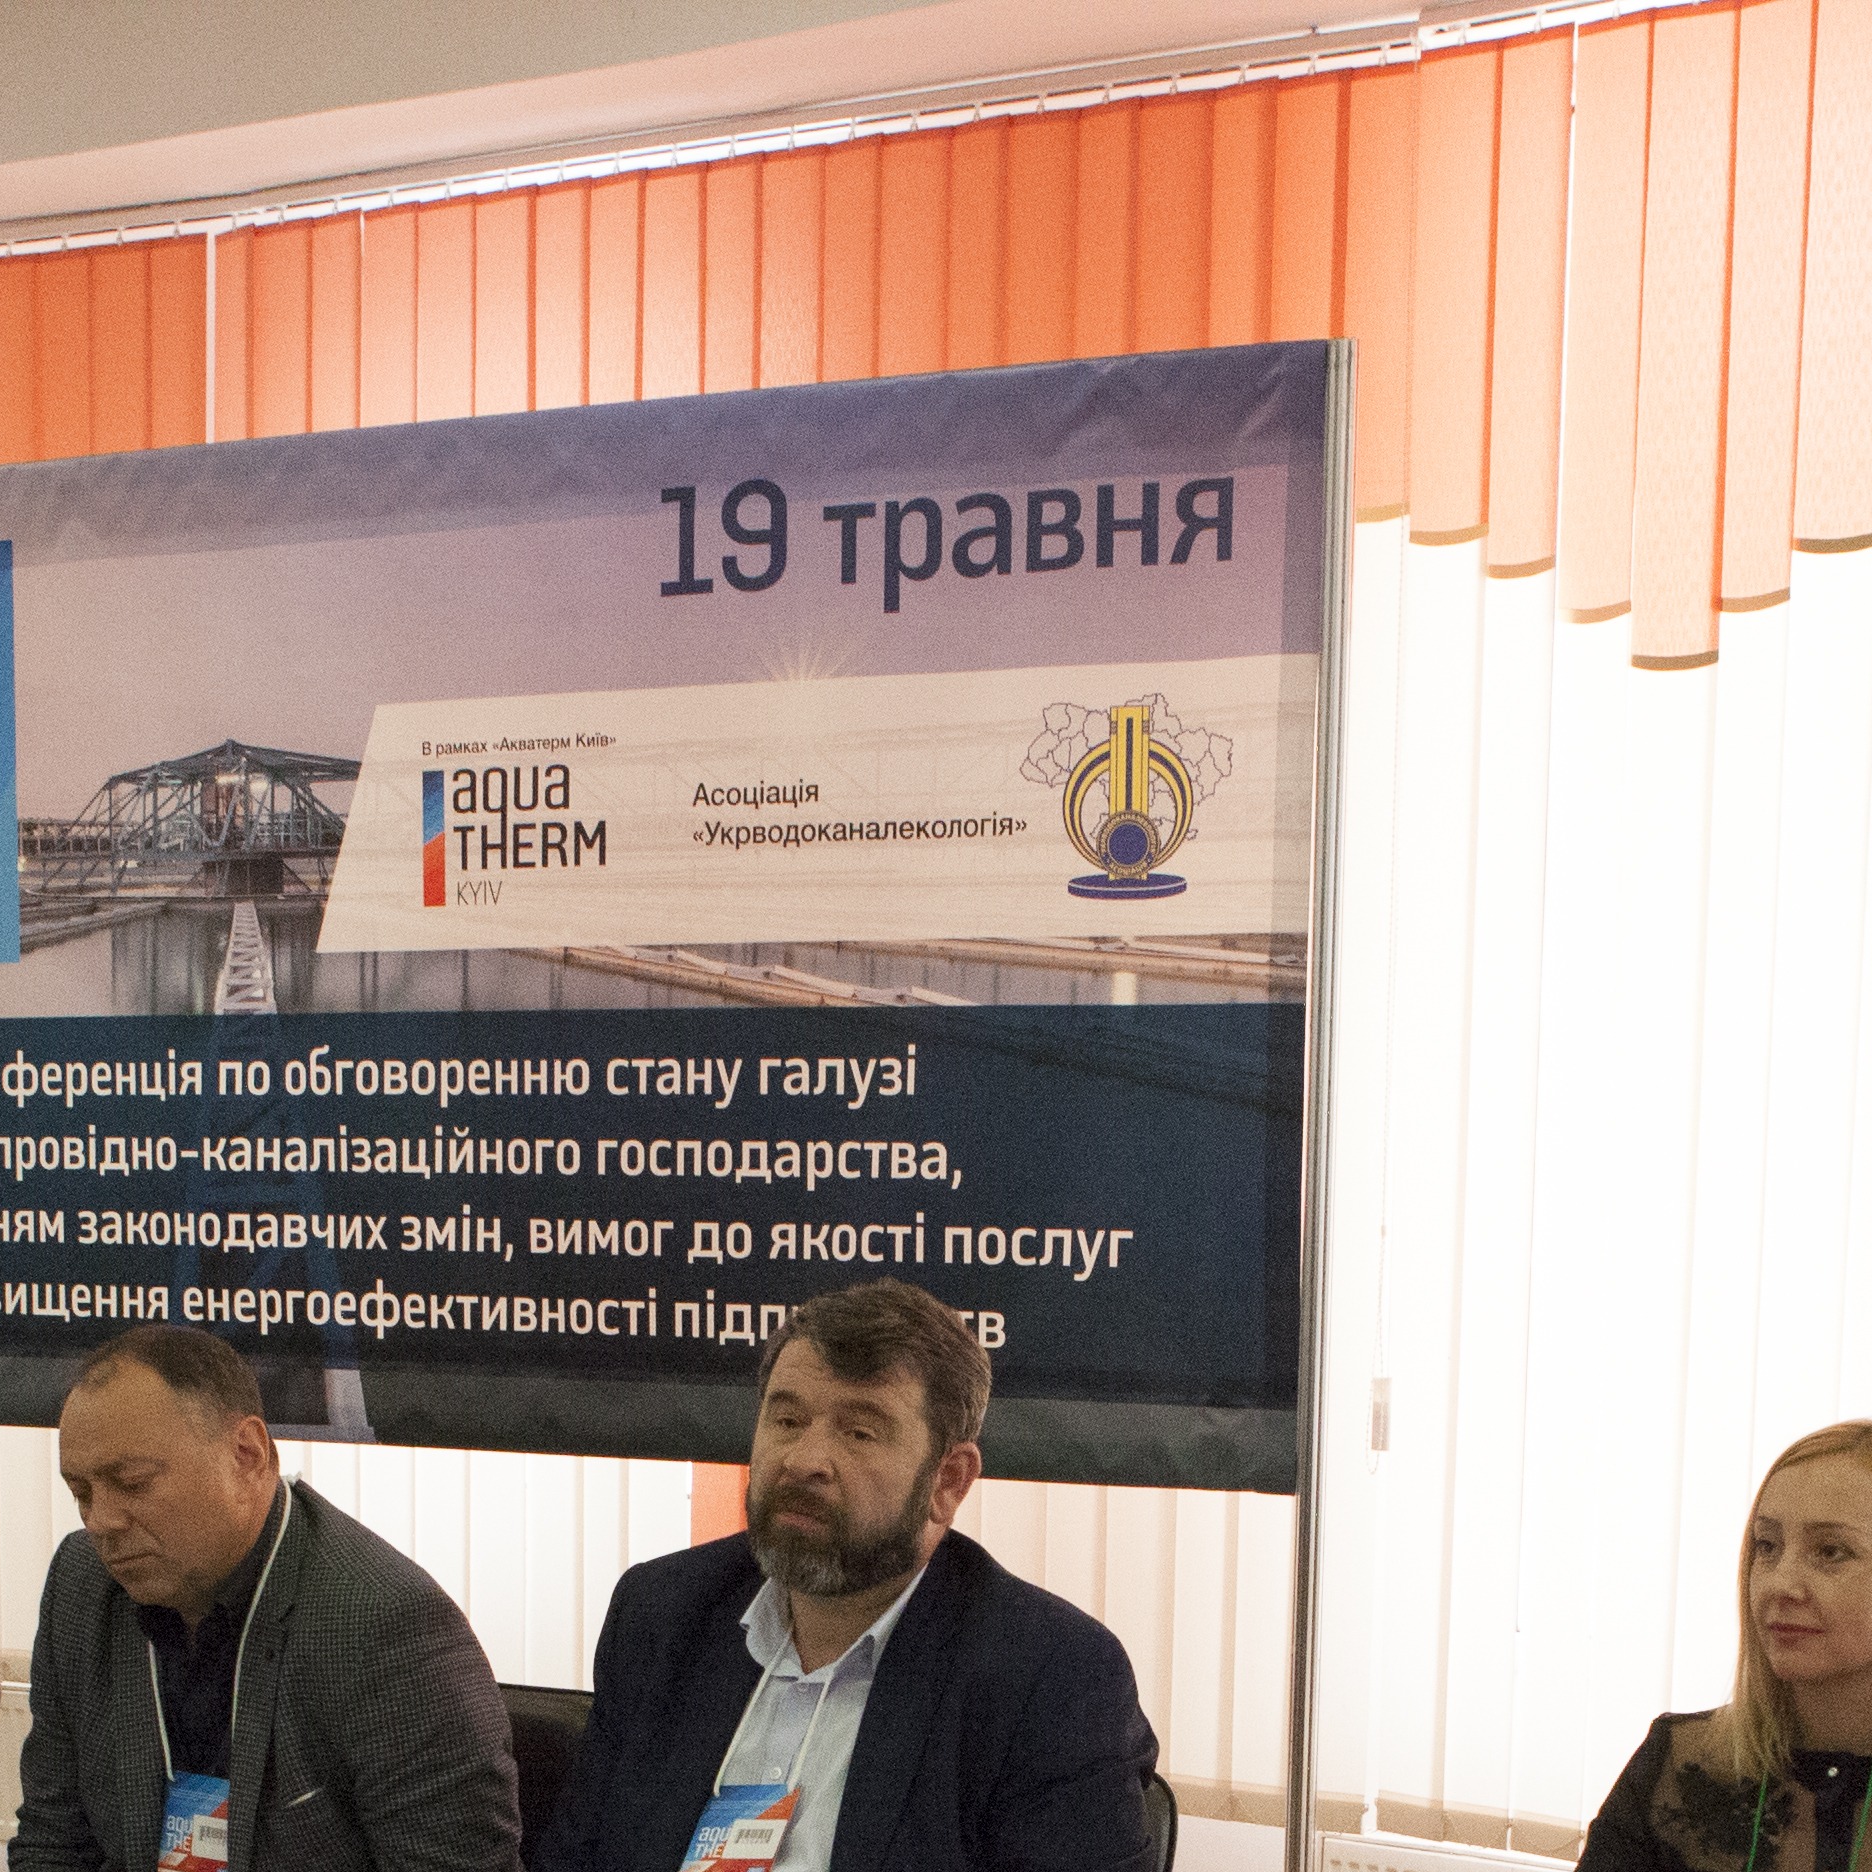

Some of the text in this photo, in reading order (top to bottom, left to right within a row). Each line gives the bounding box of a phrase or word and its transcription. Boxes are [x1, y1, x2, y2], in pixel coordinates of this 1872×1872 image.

[660, 476, 1235, 615] 19 травня
[421, 732, 617, 759] В рамках «Акватерм Київ»
[452, 763, 570, 816] aqua
[692, 778, 820, 809] Асоціація
[452, 820, 607, 871] THERM
[691, 810, 1029, 850] «Укрводоканалекологія»
[457, 879, 503, 906] KYIV
[218, 1059, 271, 1096] по
[284, 1044, 591, 1108] обговоренню
[605, 1056, 743, 1109] стану
[758, 1044, 917, 1109] галузі
[596, 1138, 963, 1191] господарства,
[77, 1212, 388, 1254] законодавчих
[400, 1204, 515, 1262] змін,
[529, 1216, 674, 1257] вимог
[686, 1220, 753, 1265] до
[769, 1211, 926, 1263] якості
[943, 1224, 1135, 1282] послуг
[182, 1278, 658, 1340] енергоефективності
[673, 1288, 1007, 1349] підптв
[165, 1815, 194, 1838] aqu
[165, 1831, 193, 1853] THE
[698, 1826, 733, 1845] aqu
[694, 1842, 725, 1859] THE
